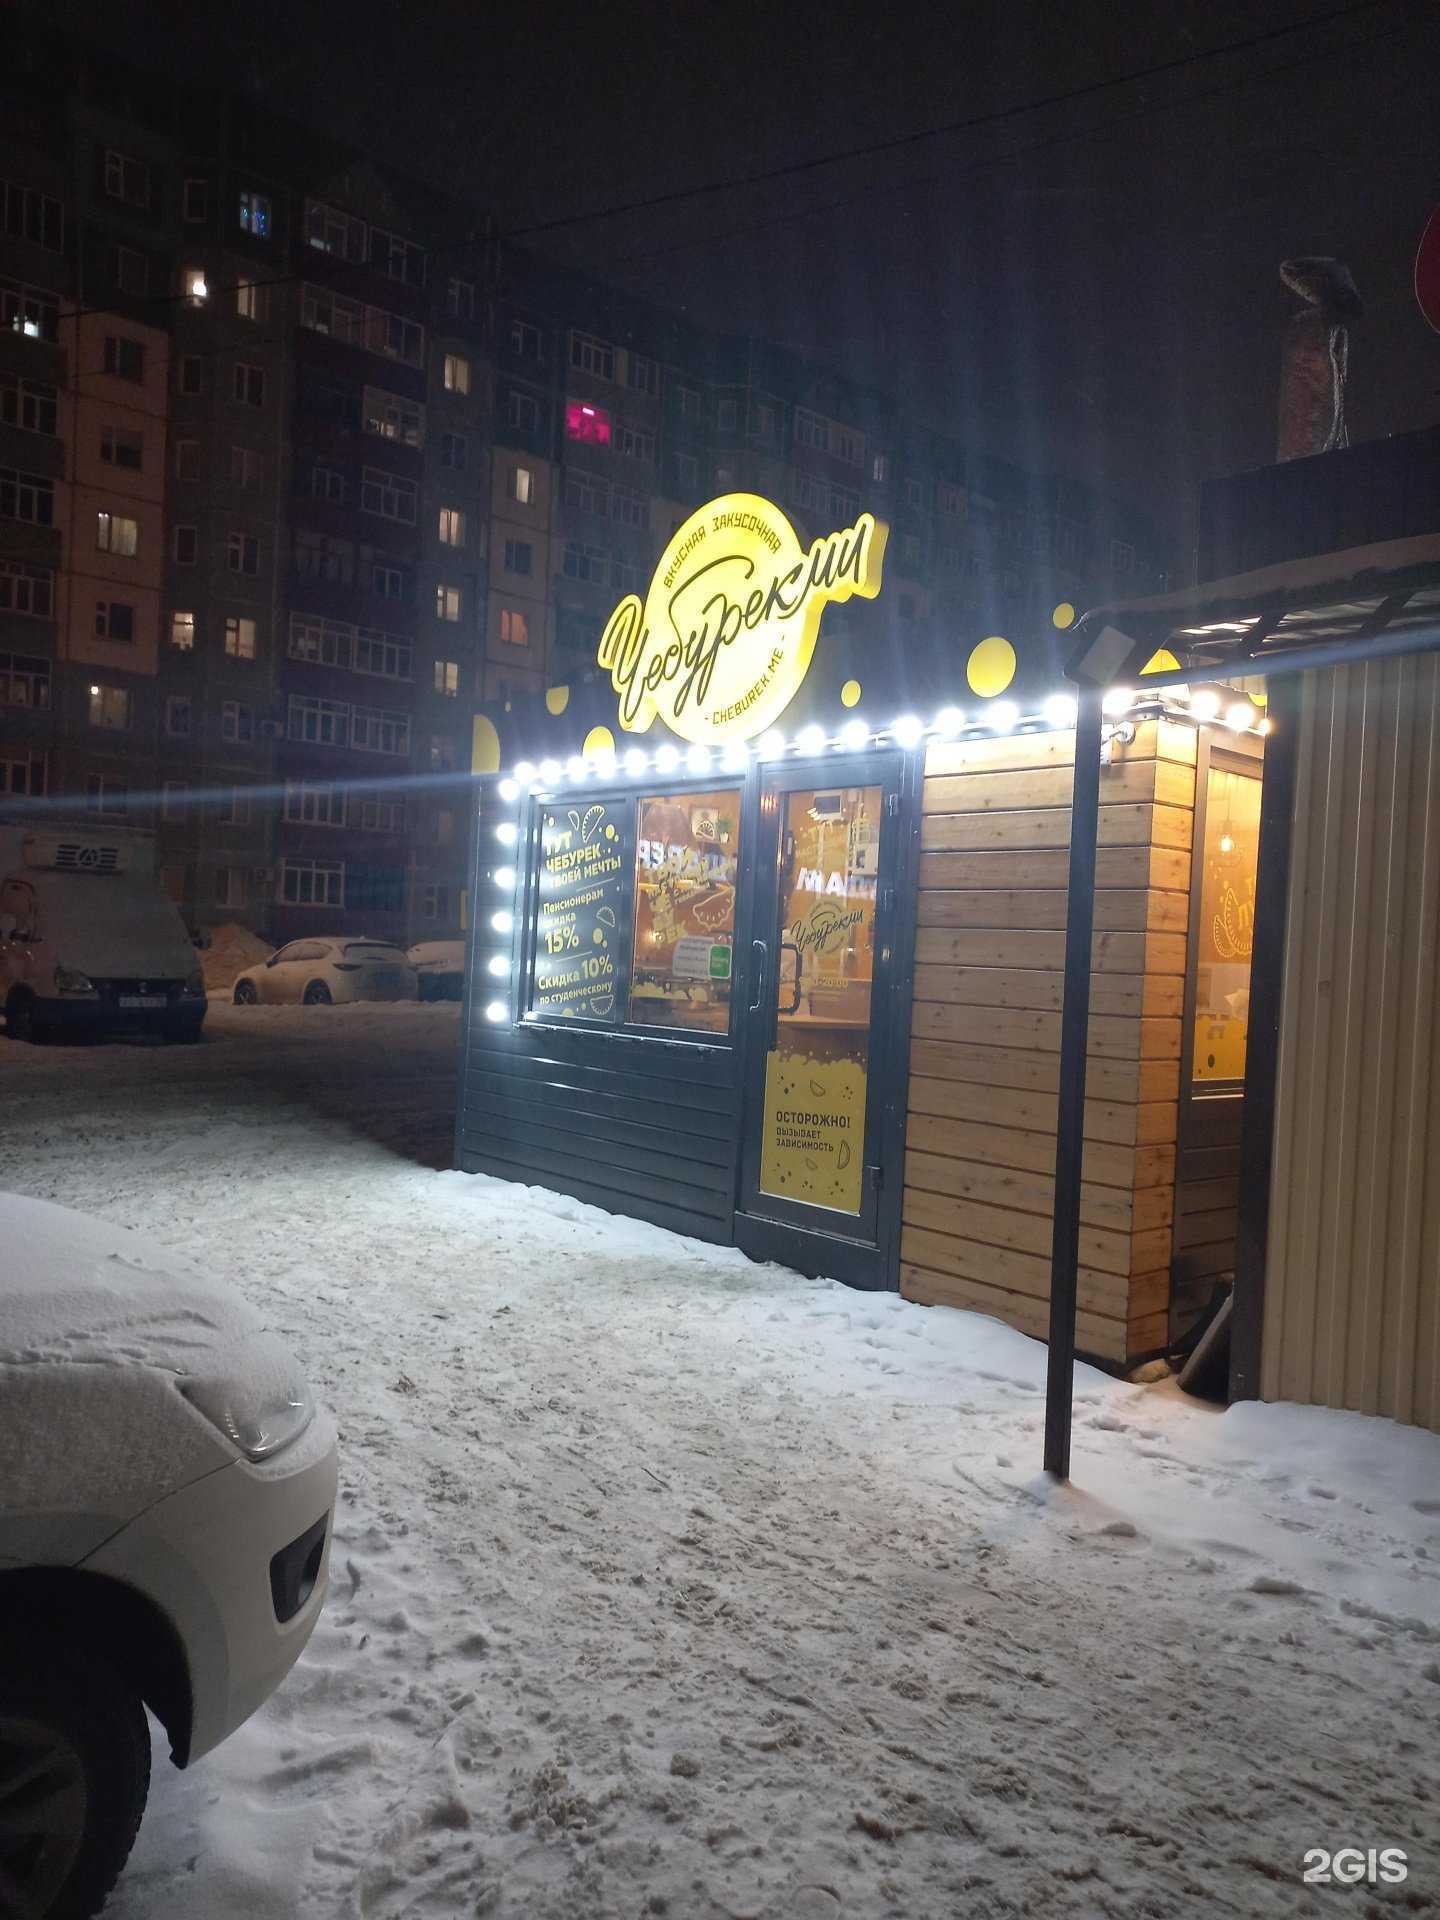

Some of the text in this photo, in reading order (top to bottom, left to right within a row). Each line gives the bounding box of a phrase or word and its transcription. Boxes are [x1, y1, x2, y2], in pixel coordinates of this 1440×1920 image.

[663, 511, 782, 588] ВКУСНАЯ ЗАКУСОЧНАЯ
[603, 523, 867, 723] Чебурекми
[545, 842, 602, 873] ЧЕБУРЕК
[583, 854, 622, 879] МЕЧТЫ
[543, 888, 604, 915] Пенсионерам
[544, 924, 580, 954] 15%
[538, 953, 613, 991] Скидка 10%
[539, 981, 613, 1006] по студенческому
[775, 1110, 851, 1129] ОСТОРОЖНО!
[776, 1127, 822, 1139] ВЫЗЫВАЕТ
[775, 1138, 834, 1153] ЗАВИСИМОСТЬ
